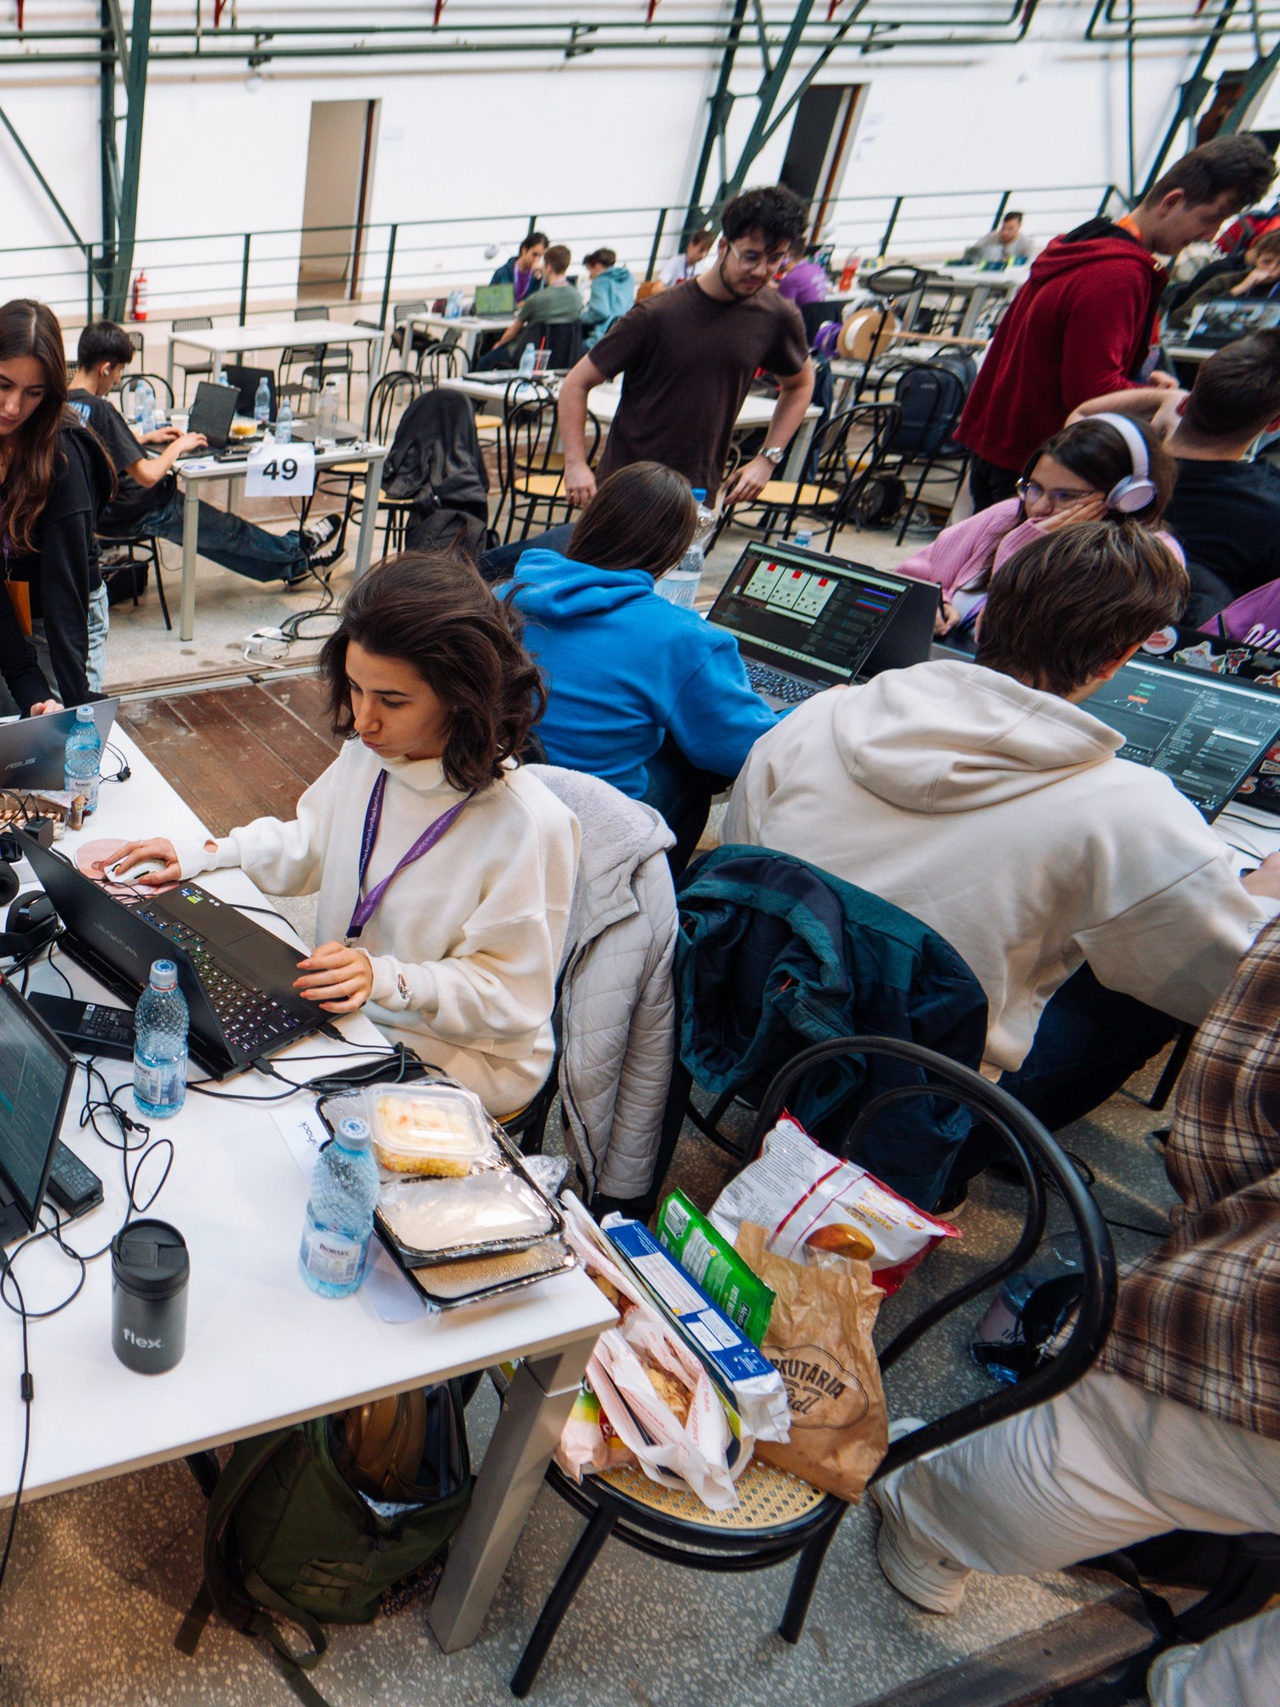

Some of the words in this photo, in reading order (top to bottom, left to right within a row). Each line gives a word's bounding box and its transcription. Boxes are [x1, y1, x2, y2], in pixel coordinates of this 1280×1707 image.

[262, 458, 298, 480] 49
[4, 757, 36, 771] ASUS
[122, 1327, 162, 1349] flex
